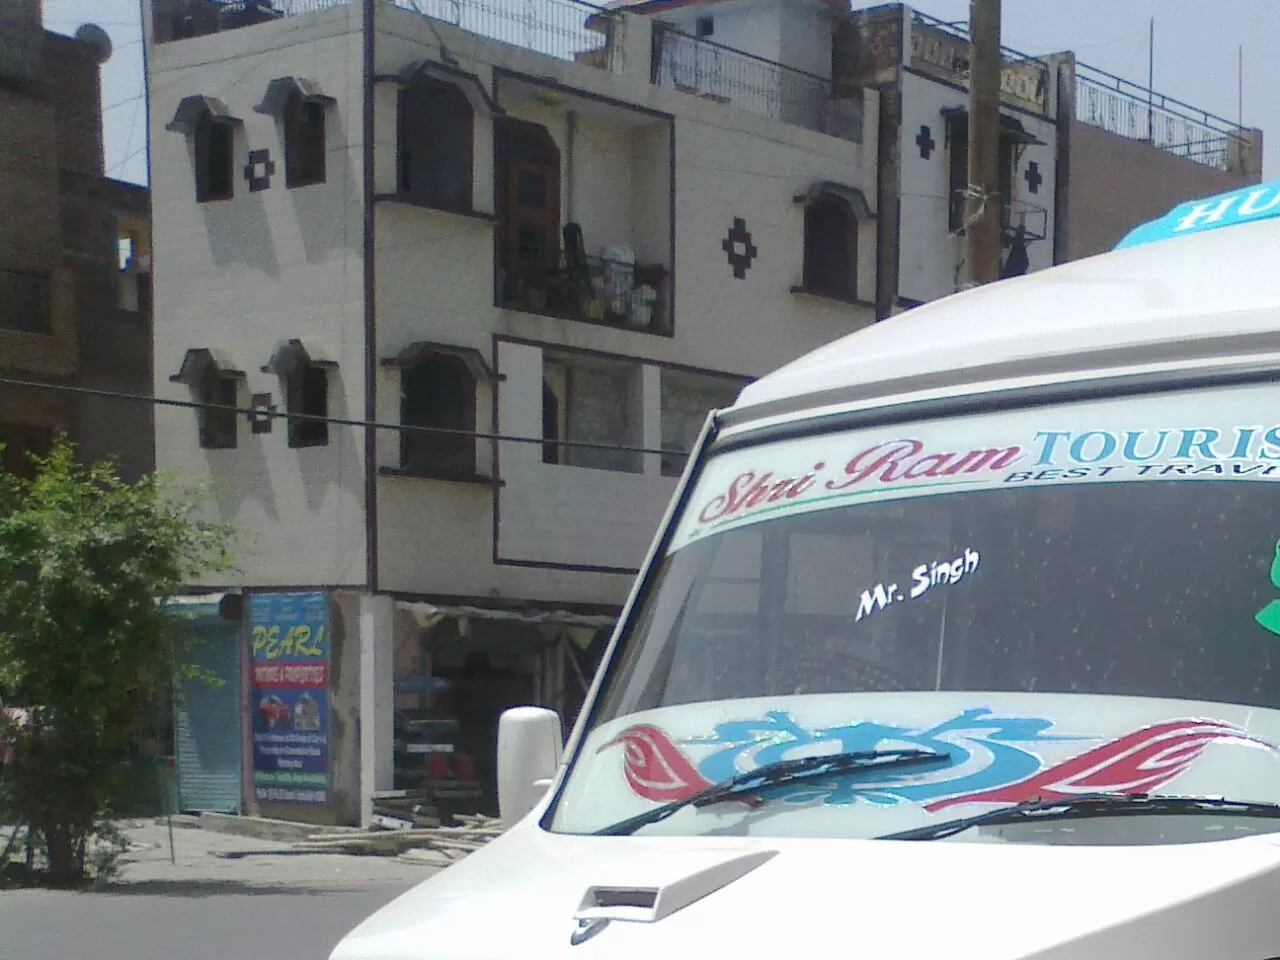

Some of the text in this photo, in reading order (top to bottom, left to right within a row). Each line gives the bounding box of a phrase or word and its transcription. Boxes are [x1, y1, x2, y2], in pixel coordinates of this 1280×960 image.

[825, 438, 1024, 490] Ram
[1003, 465, 1125, 484] BEST
[855, 547, 979, 622] Mr. Singh
[252, 624, 325, 660] PEARL
